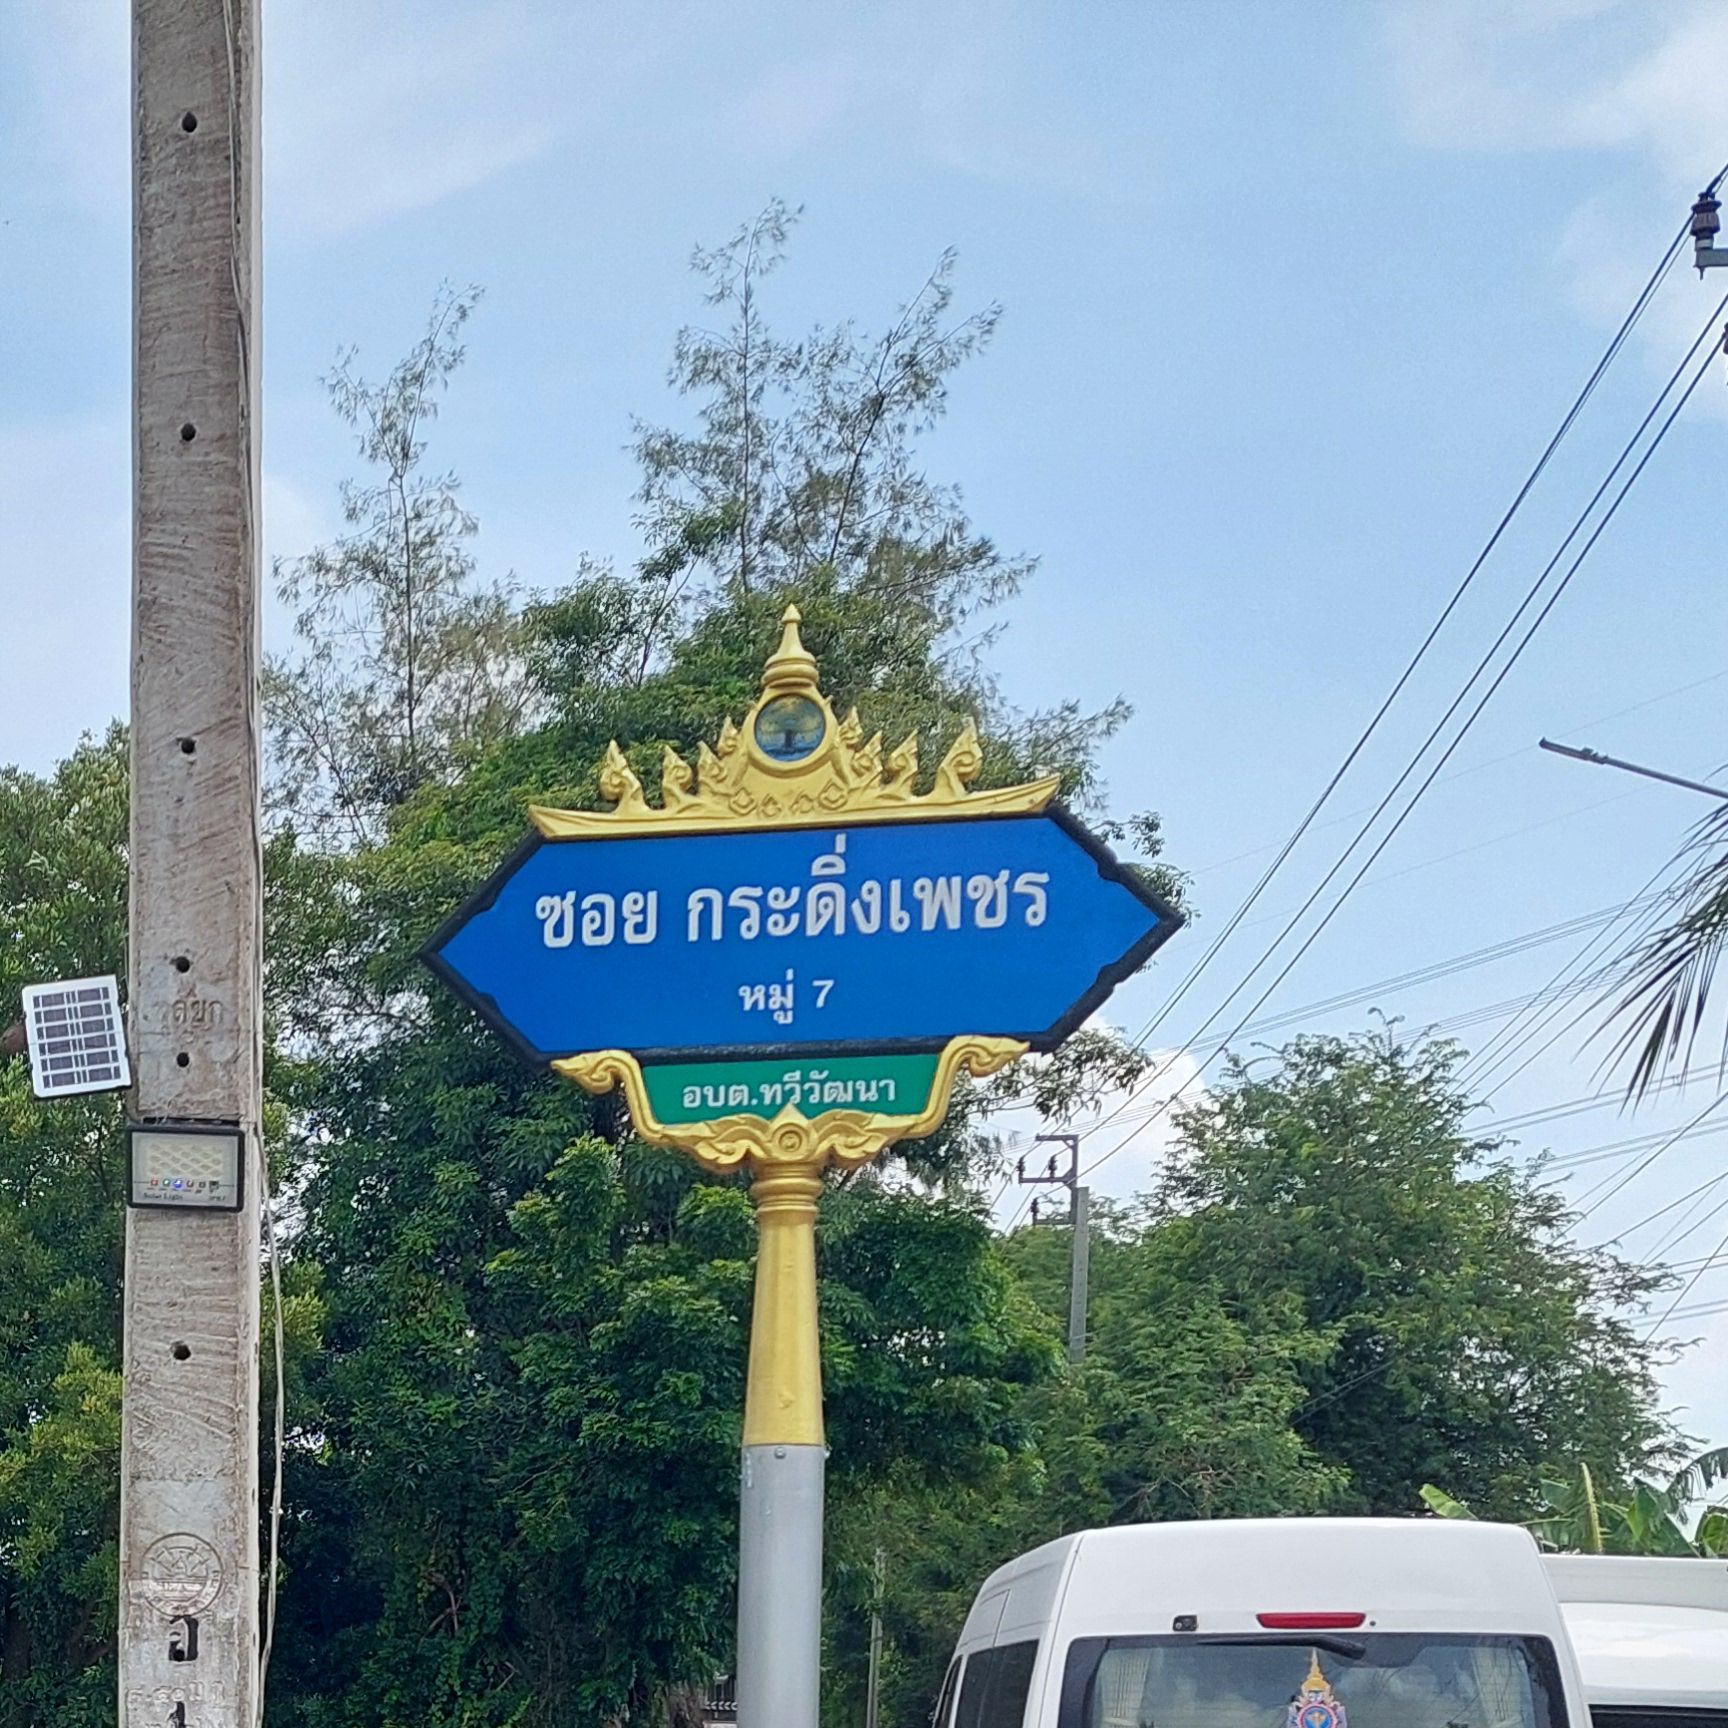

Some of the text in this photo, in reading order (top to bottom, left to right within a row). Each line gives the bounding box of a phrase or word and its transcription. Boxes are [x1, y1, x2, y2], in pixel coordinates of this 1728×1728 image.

[535, 834, 1050, 949] ซอย กระดิ่งเพชร
[739, 969, 835, 1024] หมู่ 7
[683, 1071, 896, 1109] อบต.ทวีวัฒนา
